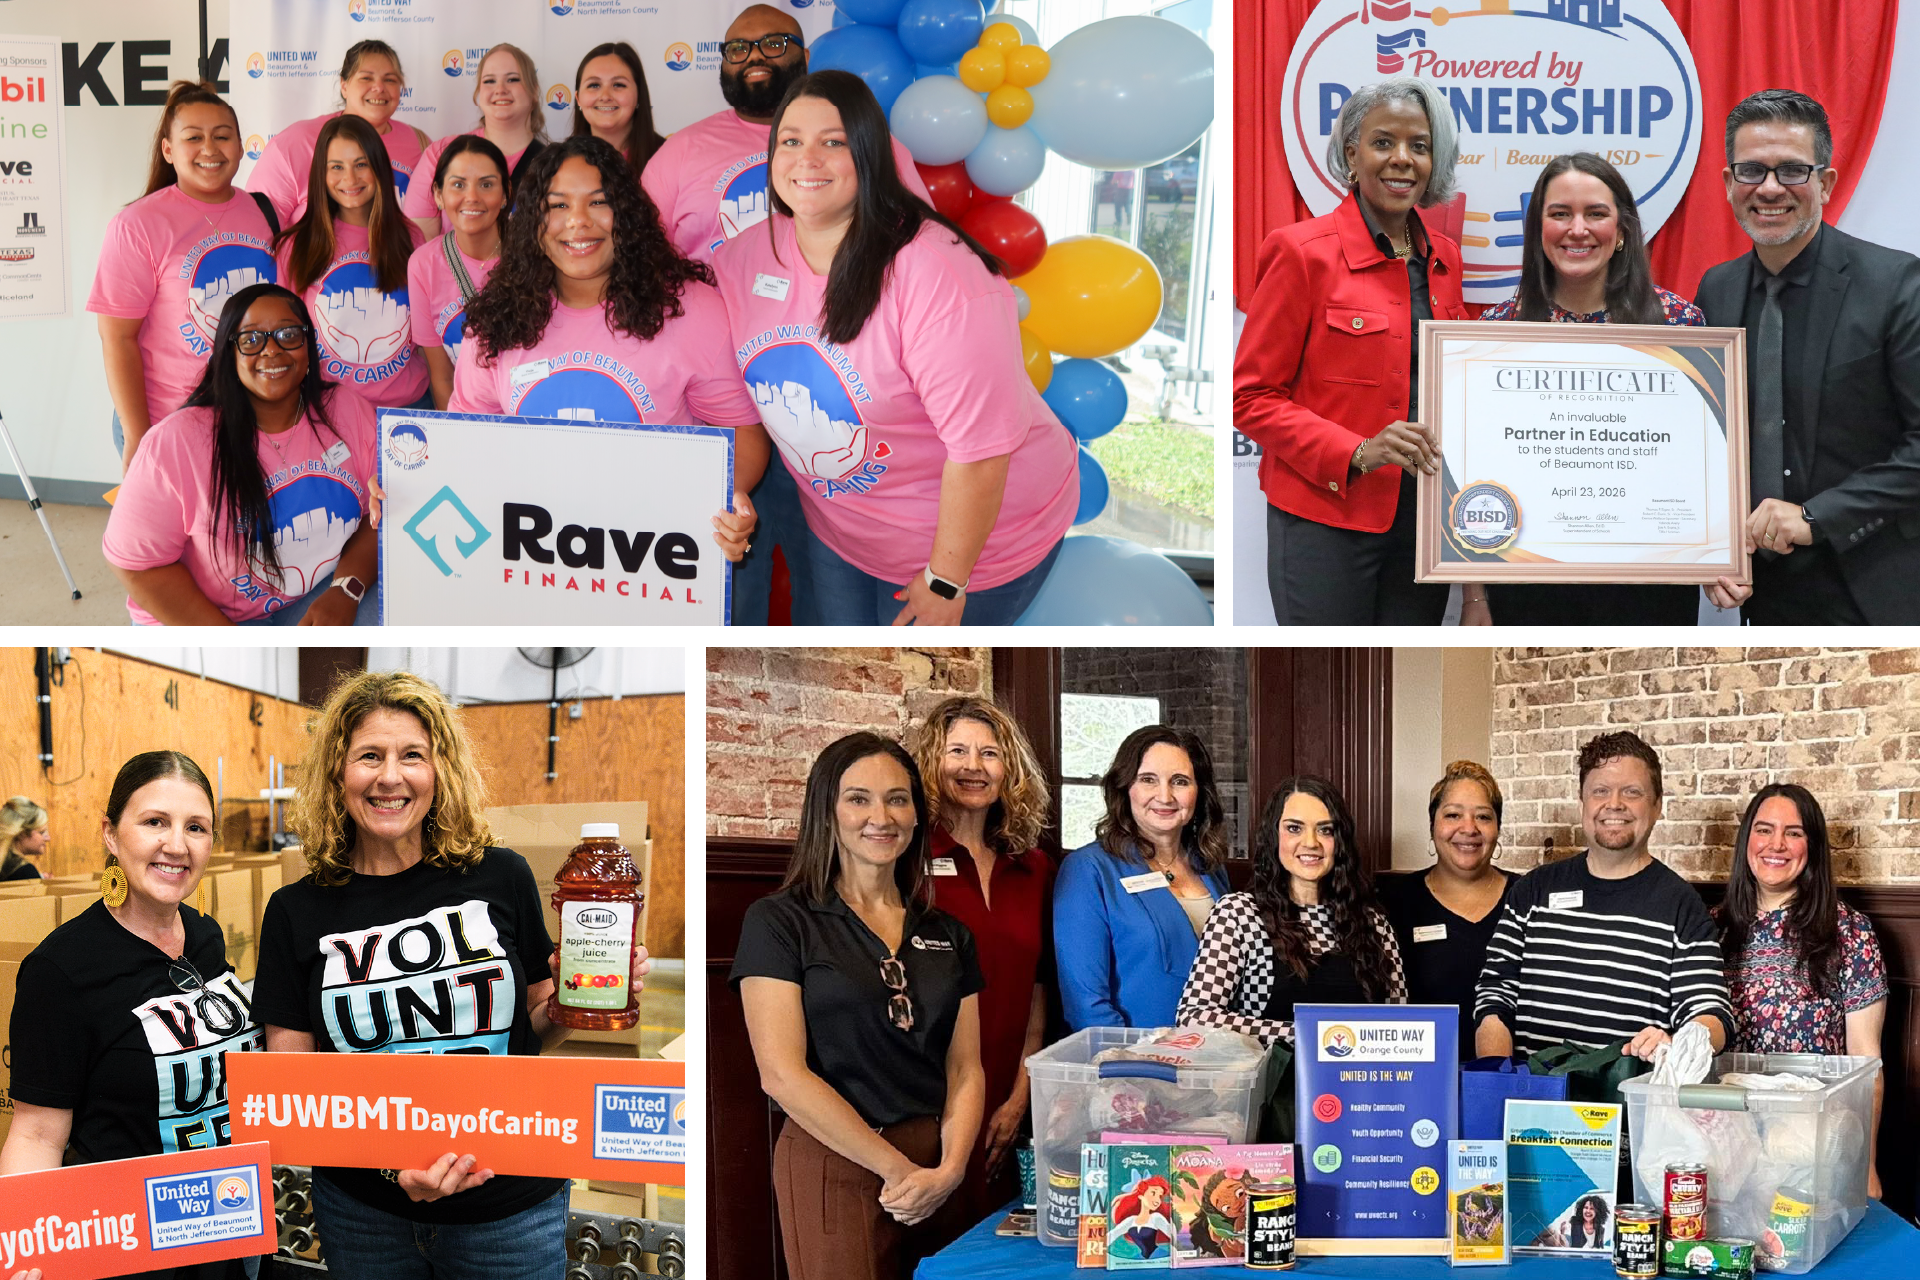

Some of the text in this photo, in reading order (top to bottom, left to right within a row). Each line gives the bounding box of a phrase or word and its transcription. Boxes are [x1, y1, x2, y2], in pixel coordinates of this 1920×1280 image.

[599, 7, 631, 15] Jefferson
[632, 6, 659, 16] County
[10, 56, 47, 67] Sponsors
[267, 51, 318, 62] UNITED WAY
[288, 70, 318, 78] Jefferson
[1408, 49, 1583, 87] Powered by
[714, 162, 746, 192] UNITED
[180, 232, 236, 280] UNITED WAY OF
[436, 302, 458, 334] UNITED
[179, 322, 211, 357] DAY
[328, 346, 411, 384] OF CARING
[572, 351, 657, 414] OF BEAUMONT
[1496, 368, 1675, 393] CERTIFICATE
[1558, 394, 1635, 402] RECOGNITION
[1550, 412, 1627, 423] An invaluable
[1504, 427, 1671, 443] Partner in Education
[1518, 445, 1658, 456] to the students and staff
[385, 448, 426, 471] DAY OF CARING
[1540, 458, 1637, 470] of Beaumont ISD.
[291, 462, 306, 477] OF
[1551, 487, 1626, 498] April 23, 2026
[1466, 510, 1506, 523] BISD
[502, 502, 700, 580] Rave
[230, 574, 268, 602] DAY
[504, 568, 697, 604] FINANCIAL
[164, 678, 179, 711] 41
[329, 910, 494, 985] VOL
[566, 938, 626, 948] apple-cherry
[582, 948, 607, 958] juice
[332, 965, 504, 1051] UNT
[1360, 1029, 1425, 1042] UNITED WAY
[1360, 1046, 1424, 1056] Orange County
[1340, 1070, 1414, 1082] UNITED IS THE WAY
[605, 1095, 667, 1113] United
[1350, 1103, 1406, 1112] Healthy Community
[242, 1094, 579, 1145] #UWBMTDayofCaring
[1590, 1110, 1608, 1118] Rave
[628, 1112, 666, 1134] Way
[1352, 1129, 1404, 1138] Youth Opportunity
[1510, 1134, 1613, 1146] Breakfast Connection
[601, 1137, 630, 1146] United
[632, 1138, 651, 1148] Way
[610, 1146, 635, 1155] North
[638, 1148, 681, 1157] Jefferson
[1177, 1156, 1224, 1168] MOANA
[1352, 1154, 1404, 1164] Financial Security
[1458, 1156, 1498, 1168] UNITED IS
[1458, 1168, 1474, 1180] THE
[1475, 1168, 1494, 1180] WAY
[155, 1181, 210, 1202] United
[1345, 1180, 1410, 1190] Community Resiliency
[177, 1200, 210, 1217] Way
[157, 1216, 253, 1235] United Way of Beaumont
[1774, 1222, 1807, 1235] CARROTS
[166, 1232, 188, 1242] North
[190, 1228, 228, 1240] Jefferson
[229, 1223, 256, 1236] County
[1622, 1234, 1654, 1243] RANCH
[0, 1209, 139, 1270] yofCaring
[1266, 1240, 1294, 1252] BEANS
[1619, 1242, 1656, 1254] STYLE
